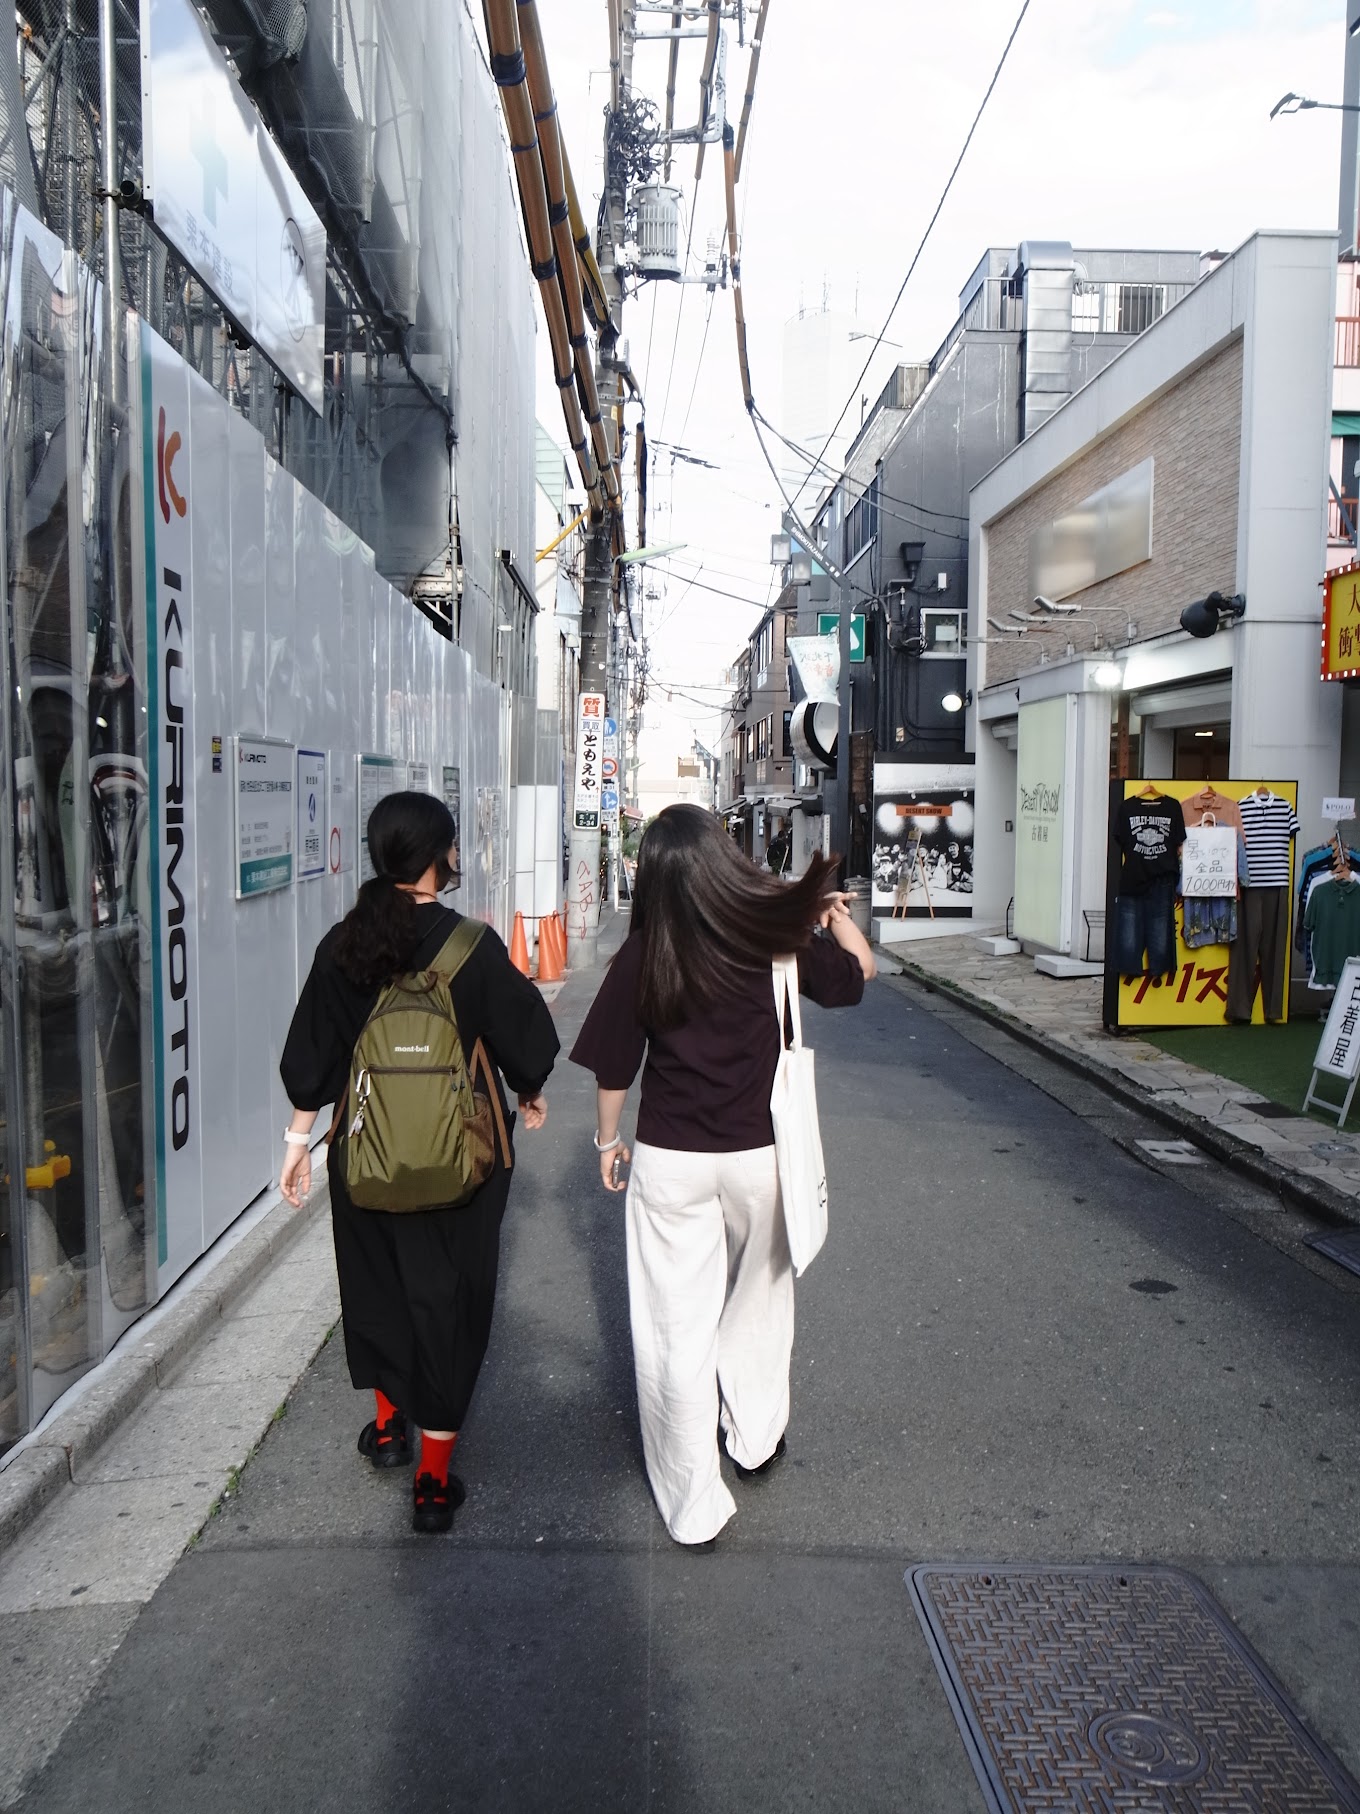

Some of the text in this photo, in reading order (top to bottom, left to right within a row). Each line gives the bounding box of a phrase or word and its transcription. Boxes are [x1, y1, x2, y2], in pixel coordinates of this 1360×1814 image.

[582, 697, 600, 717] 質
[581, 733, 597, 791] ともえや
[905, 807, 943, 815] DESERT SNOW
[163, 566, 190, 1152] KURIMOTO
[1195, 859, 1224, 874] 全品
